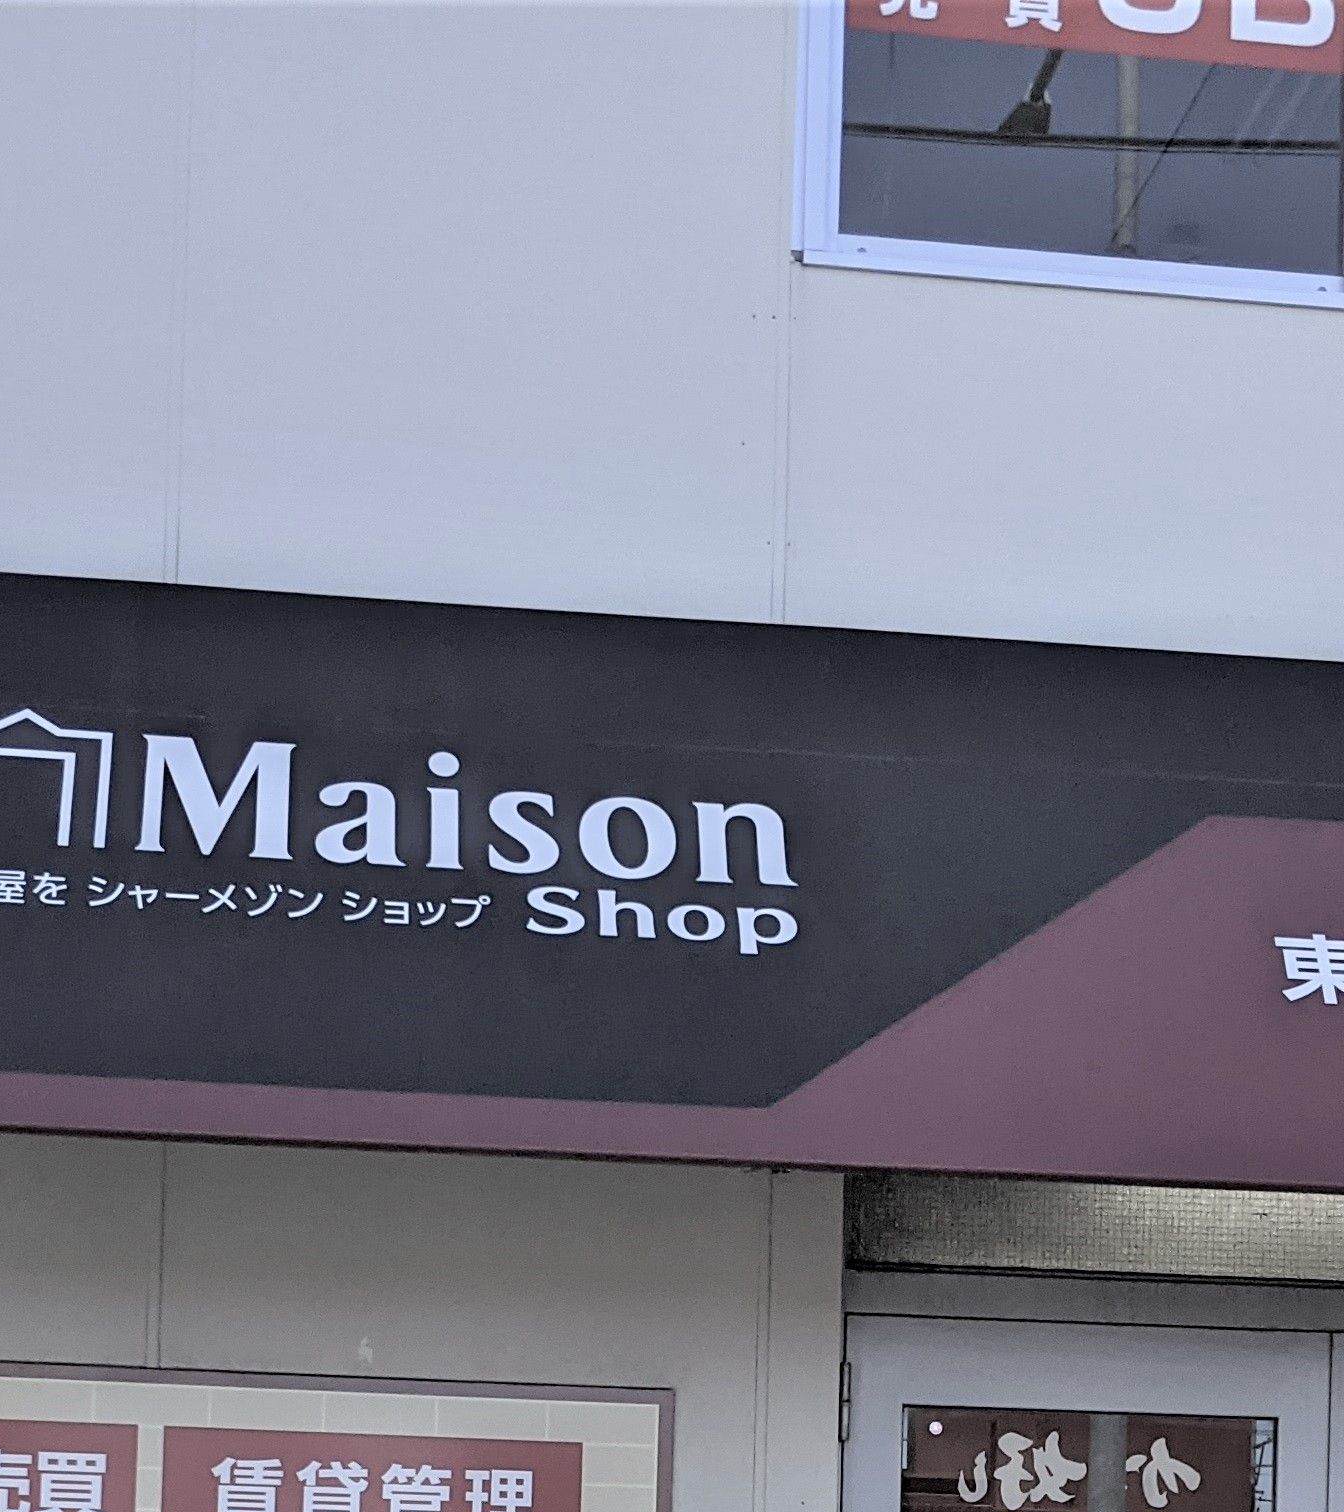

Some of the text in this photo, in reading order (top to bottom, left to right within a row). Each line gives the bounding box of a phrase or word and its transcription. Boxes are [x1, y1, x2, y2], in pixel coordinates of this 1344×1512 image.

[87, 877, 324, 919] シャーメゾン
[341, 891, 491, 929] ショップ
[526, 886, 798, 955] Shop
